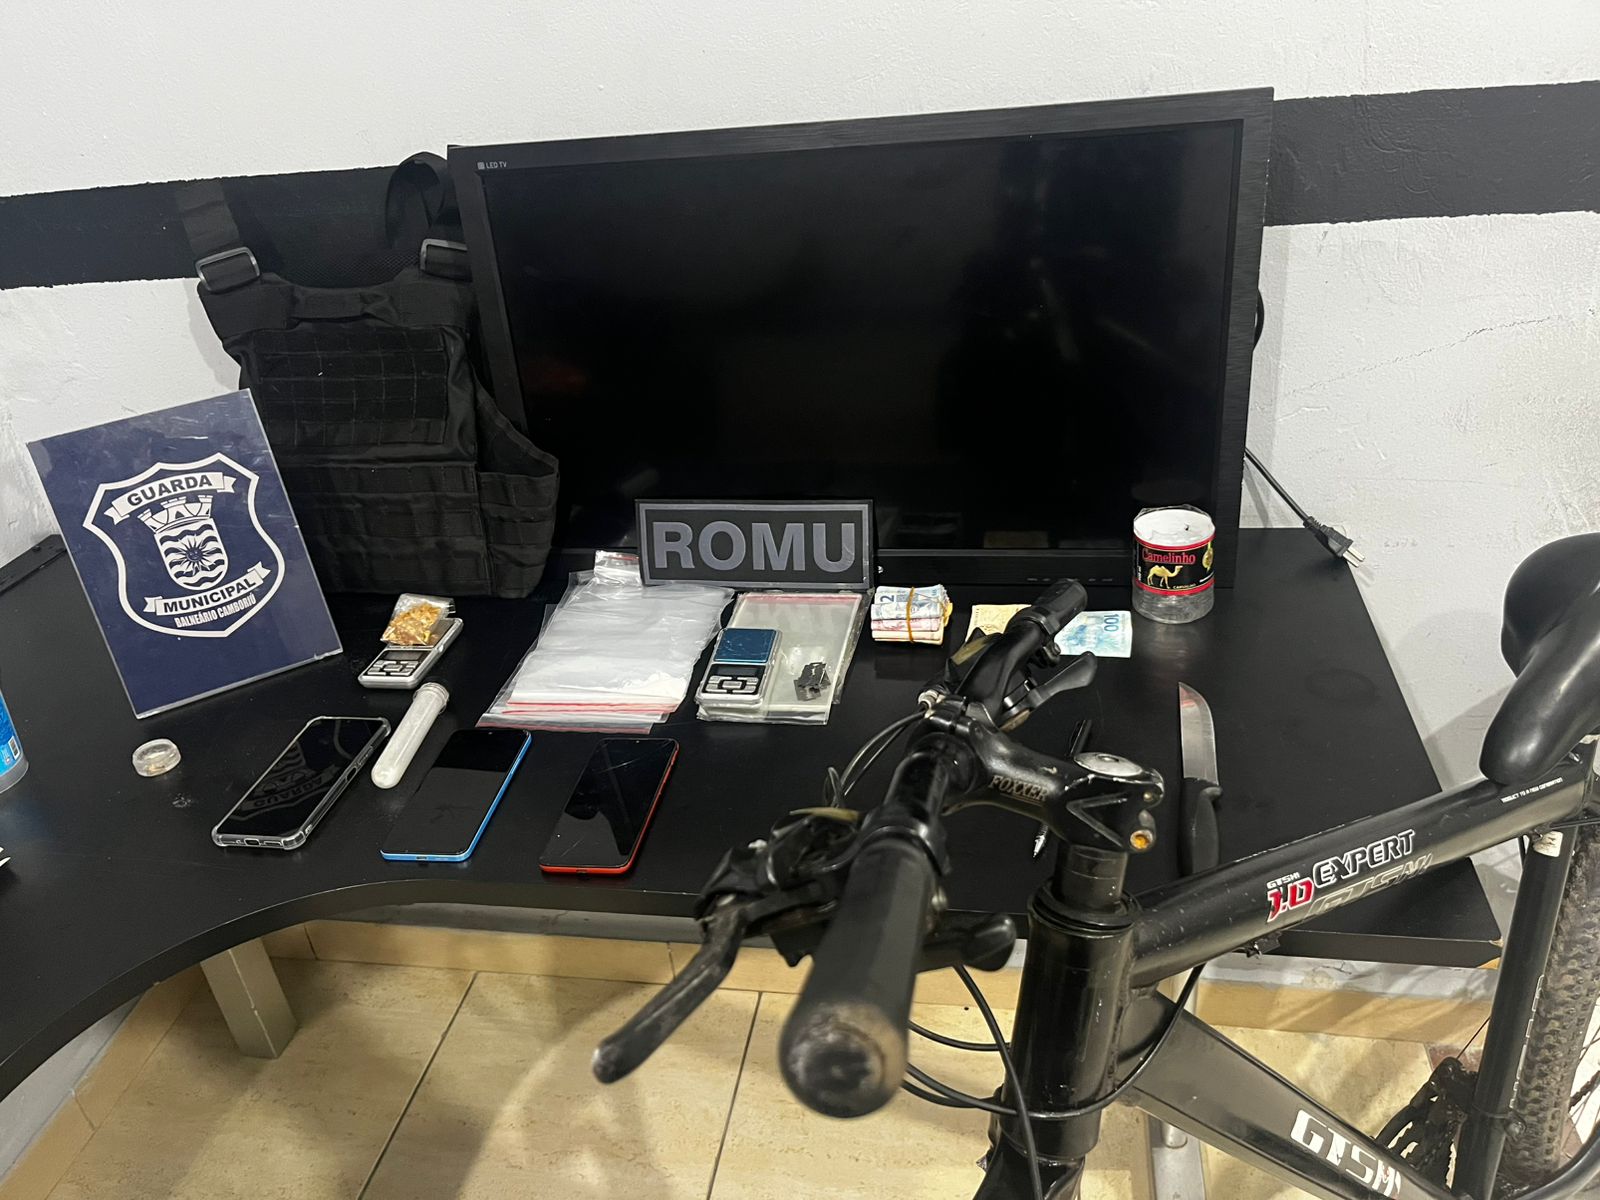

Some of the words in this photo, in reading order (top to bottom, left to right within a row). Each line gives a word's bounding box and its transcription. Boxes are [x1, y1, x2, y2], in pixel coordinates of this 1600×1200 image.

[486, 161, 498, 169] LED
[498, 160, 507, 168] TV
[127, 474, 213, 506] GUARDA
[652, 521, 855, 573] ROMU
[1142, 547, 1196, 565] Camelinho
[163, 578, 256, 613] MUNICIPAL
[174, 611, 218, 628] BALNEÁRIO
[218, 593, 256, 618] CAMBORIÚ
[1103, 614, 1119, 632] 100
[988, 775, 1049, 802] FOXXER
[1312, 829, 1416, 888] EXPERT
